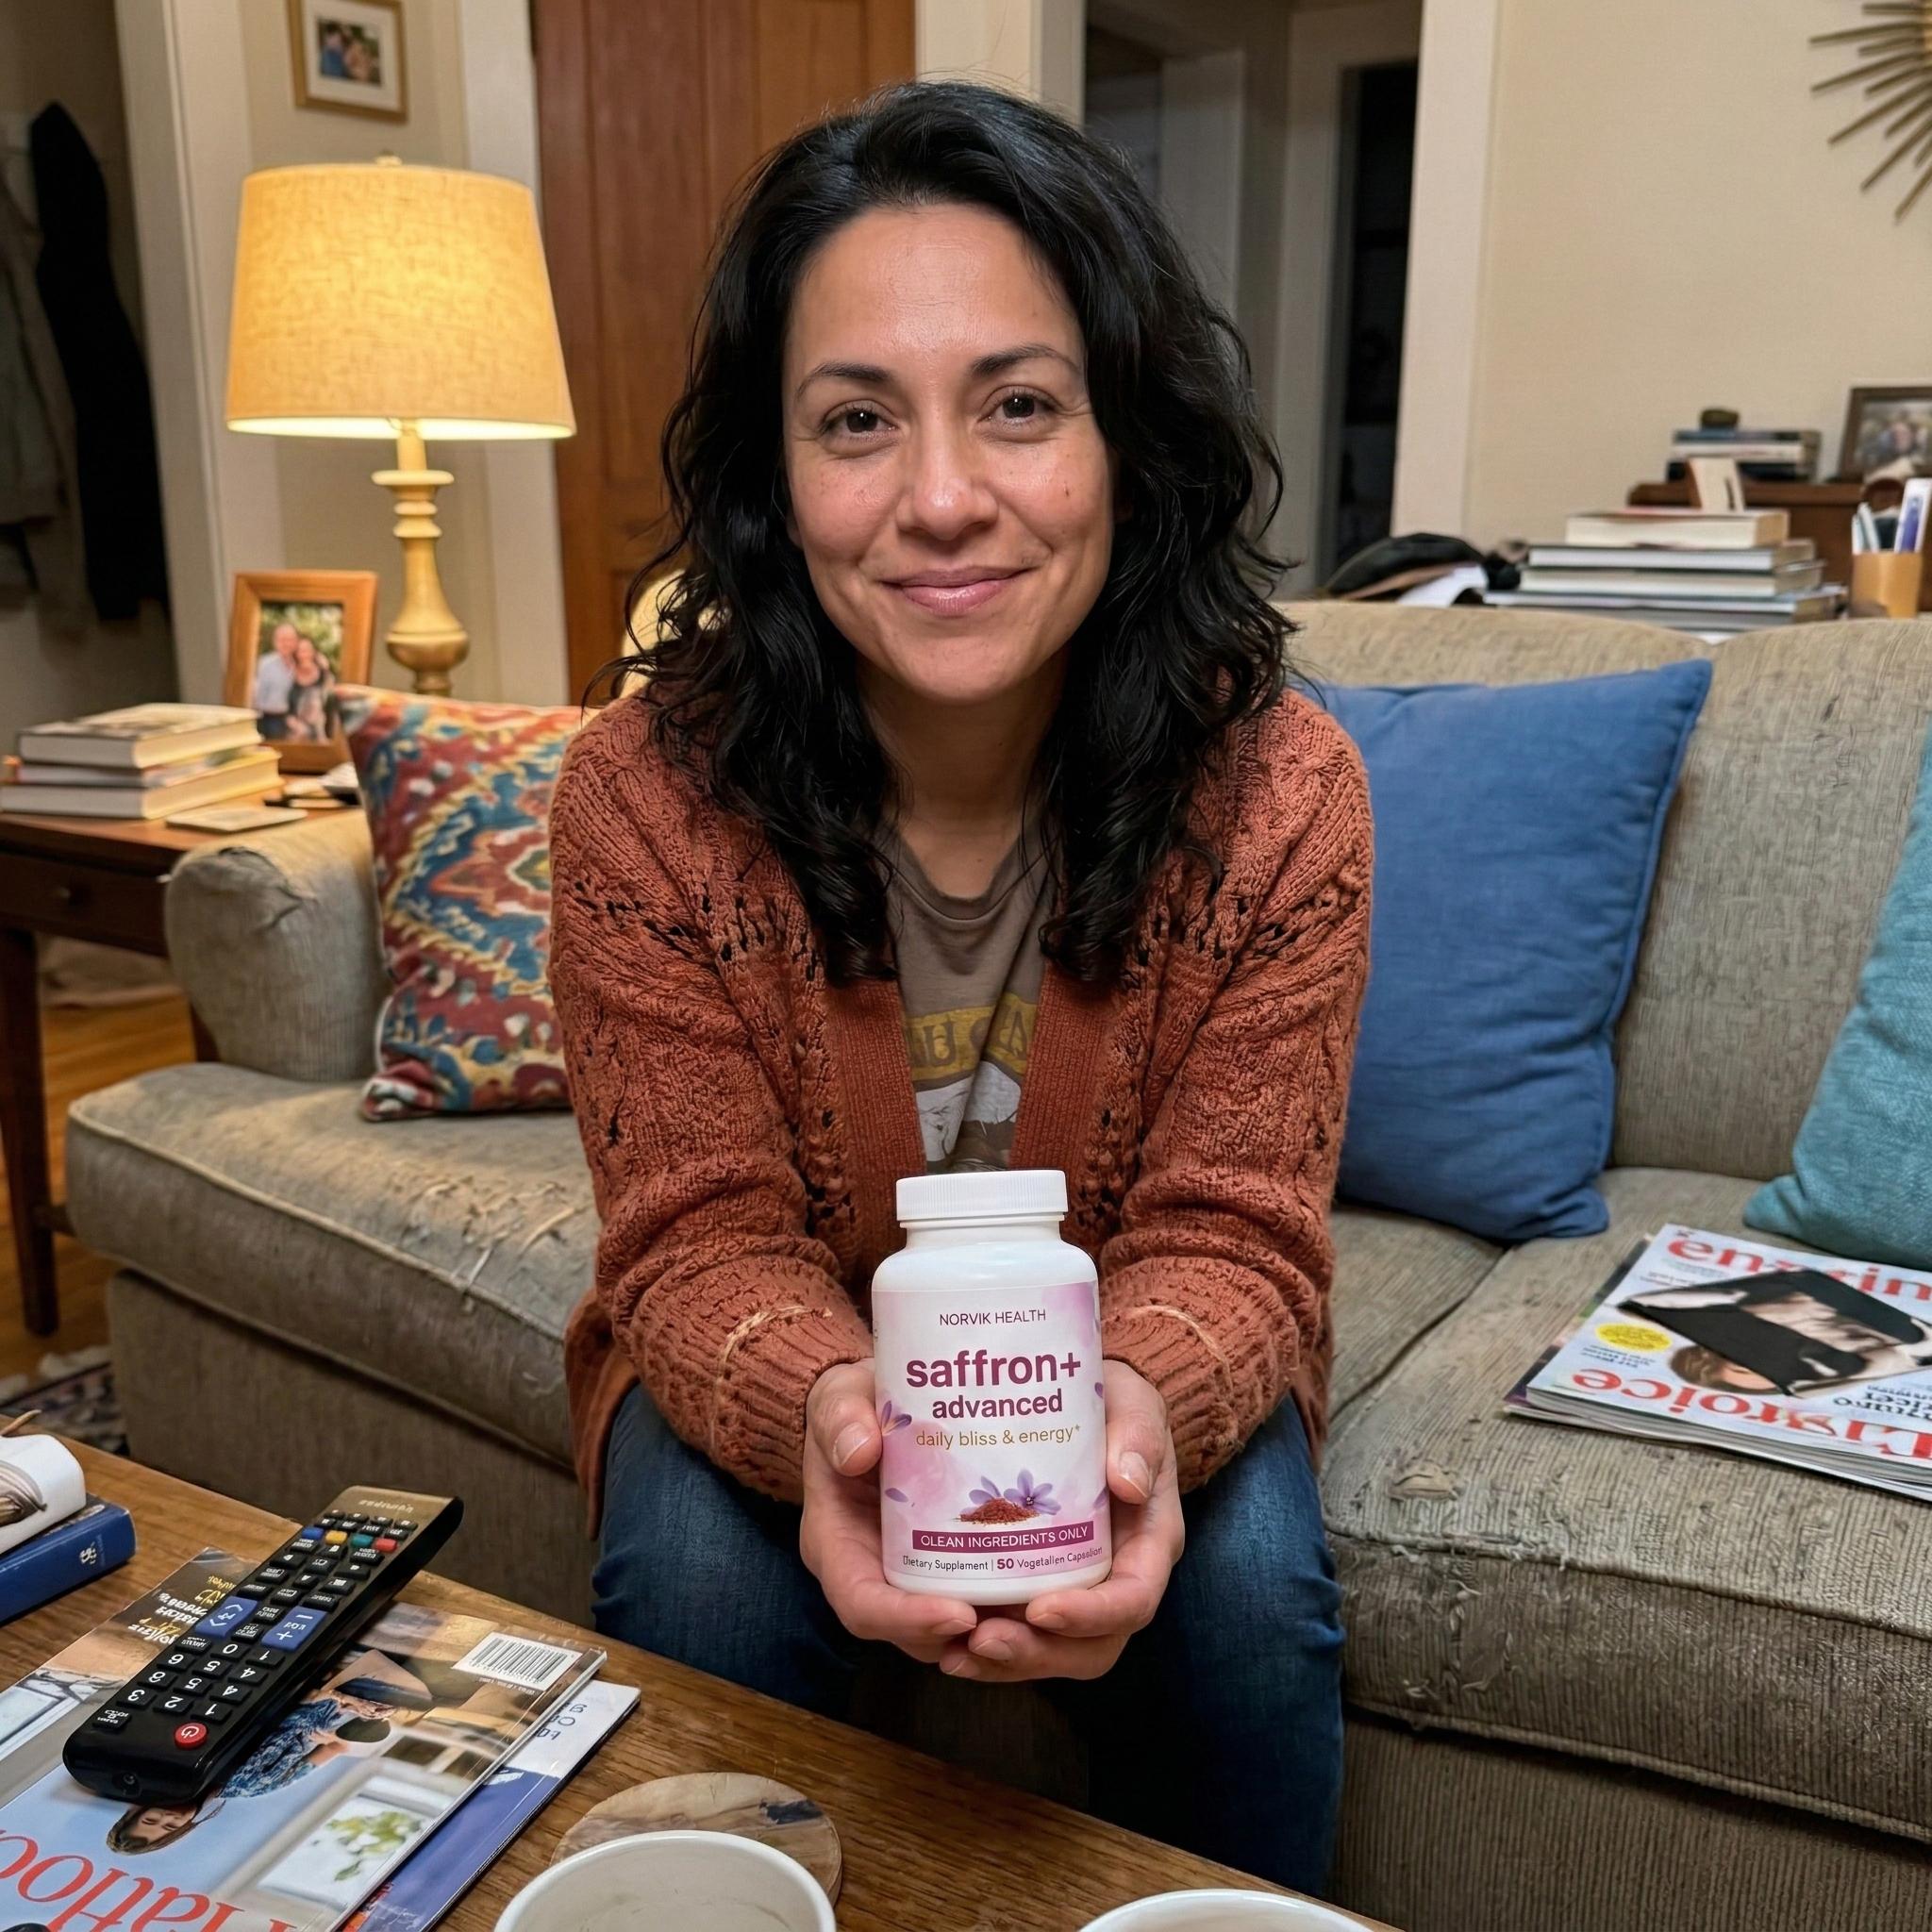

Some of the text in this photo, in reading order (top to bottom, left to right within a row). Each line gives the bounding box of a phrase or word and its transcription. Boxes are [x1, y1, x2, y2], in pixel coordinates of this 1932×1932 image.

[940, 1309, 1046, 1325] NORVIK HEALTH
[906, 1349, 1081, 1388] saffron+
[932, 1388, 1063, 1419] advanced
[916, 1430, 954, 1450] daily
[959, 1429, 997, 1446] bliss
[1003, 1429, 1015, 1444] &
[968, 1532, 1056, 1548] INGREDIENTS
[1059, 1525, 1089, 1541] ONLY
[996, 1557, 1014, 1570] 50
[222, 1643, 271, 1660] 1 0
[167, 1654, 257, 1679] 4 5 6
[127, 1689, 219, 1716] 1 2 3
